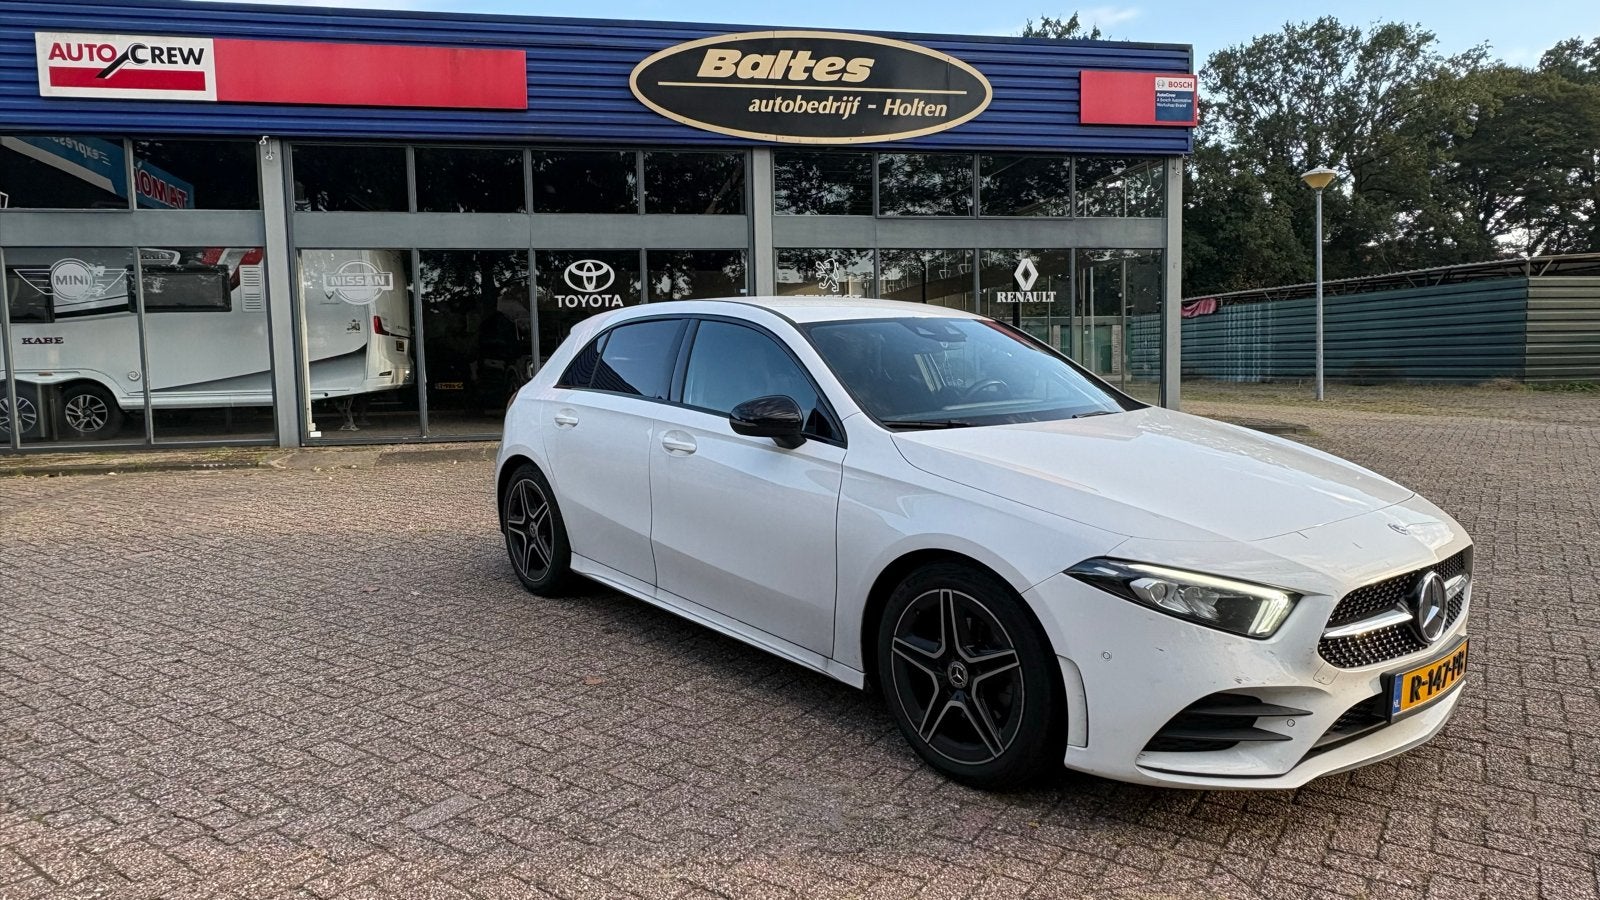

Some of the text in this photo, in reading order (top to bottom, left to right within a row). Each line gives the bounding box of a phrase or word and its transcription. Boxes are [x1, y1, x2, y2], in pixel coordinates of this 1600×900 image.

[48, 42, 205, 66] AUTO CREW
[696, 48, 875, 83] Baltes
[748, 95, 862, 120] autobedrijf
[882, 98, 948, 118] Holten
[55, 274, 89, 286] MINI
[330, 276, 386, 286] NISSAN
[554, 294, 624, 308] TOYOTA
[996, 291, 1057, 303] RENAULT
